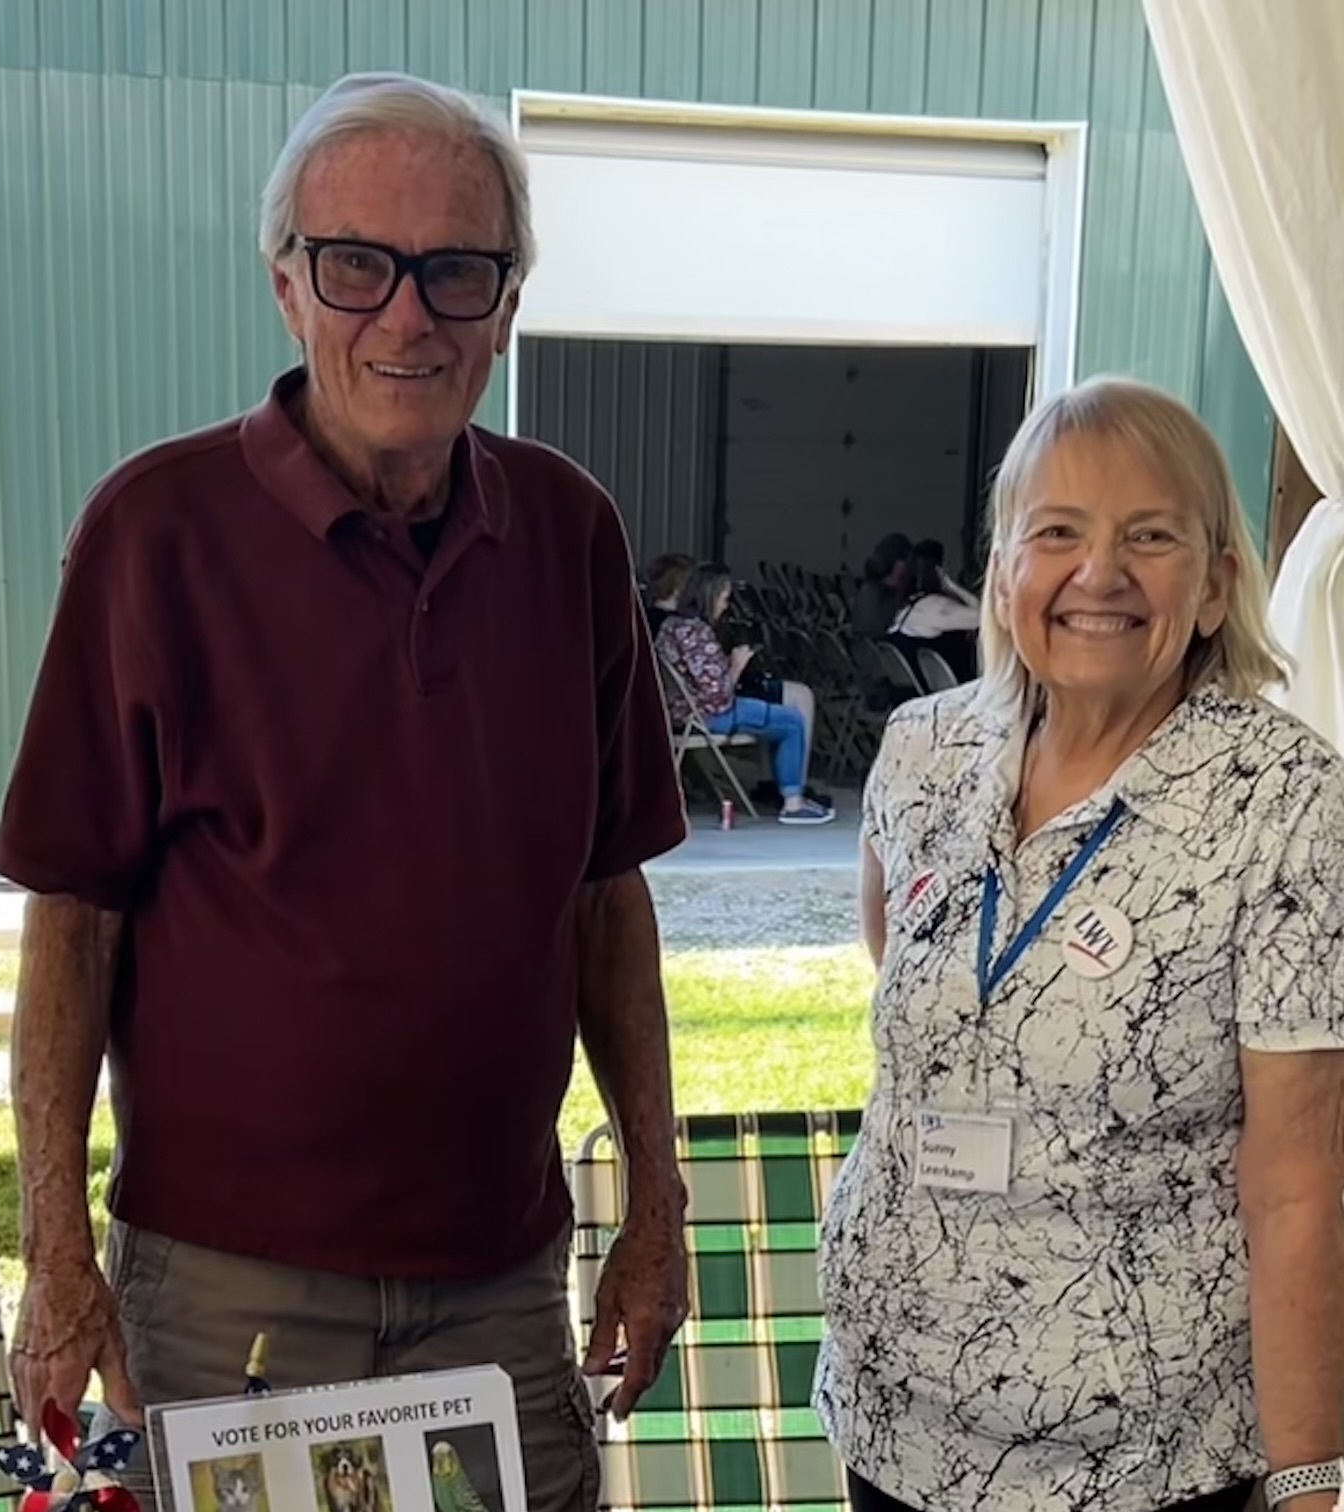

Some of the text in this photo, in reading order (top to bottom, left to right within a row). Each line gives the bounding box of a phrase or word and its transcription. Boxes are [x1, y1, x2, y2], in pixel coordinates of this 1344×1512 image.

[1074, 910, 1119, 962] LWV
[212, 1396, 474, 1448] VOTE FOR YOUR FAVORITE PET
